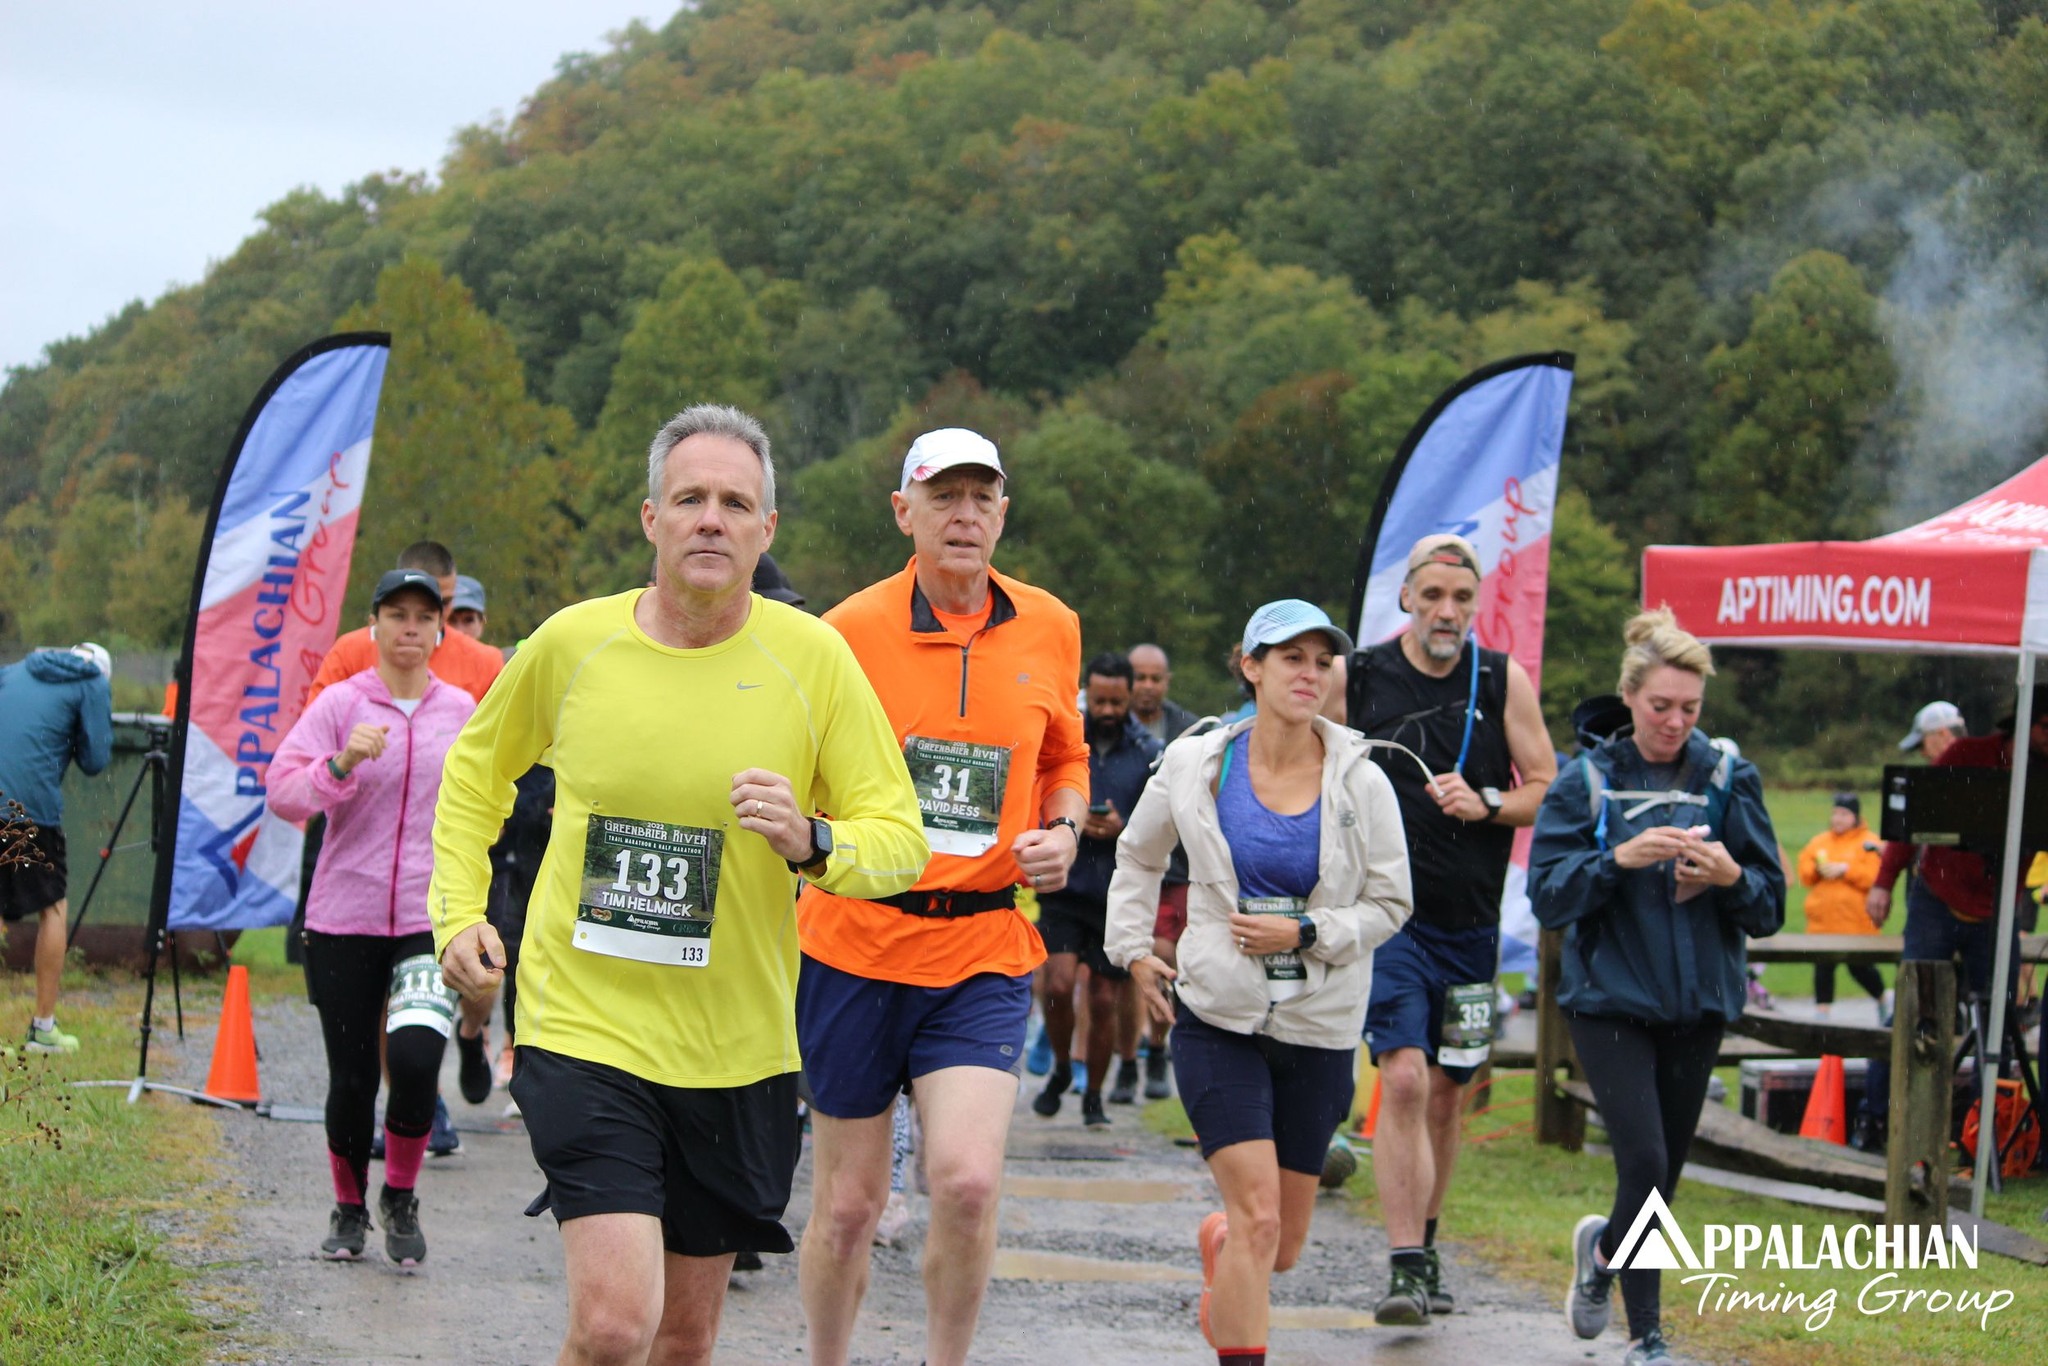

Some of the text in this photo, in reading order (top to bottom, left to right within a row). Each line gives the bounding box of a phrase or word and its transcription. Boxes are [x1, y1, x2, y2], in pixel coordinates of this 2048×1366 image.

[1478, 476, 1538, 654] Group
[1717, 574, 1931, 627] APTIMING.COM
[972, 747, 998, 760] RIVER
[931, 764, 970, 802] 31
[918, 799, 980, 817] DAVID BESS
[604, 820, 707, 846] GREENBRIER RIVER
[647, 822, 664, 830] 2022
[608, 835, 623, 843] TRAIL
[625, 838, 651, 848] MARATHON
[673, 846, 701, 854] MARATHON
[612, 849, 689, 900] 133
[602, 891, 693, 917] TIM HELMICK
[681, 947, 703, 962] 133
[402, 969, 446, 996] 118
[1459, 1001, 1491, 1030] 352
